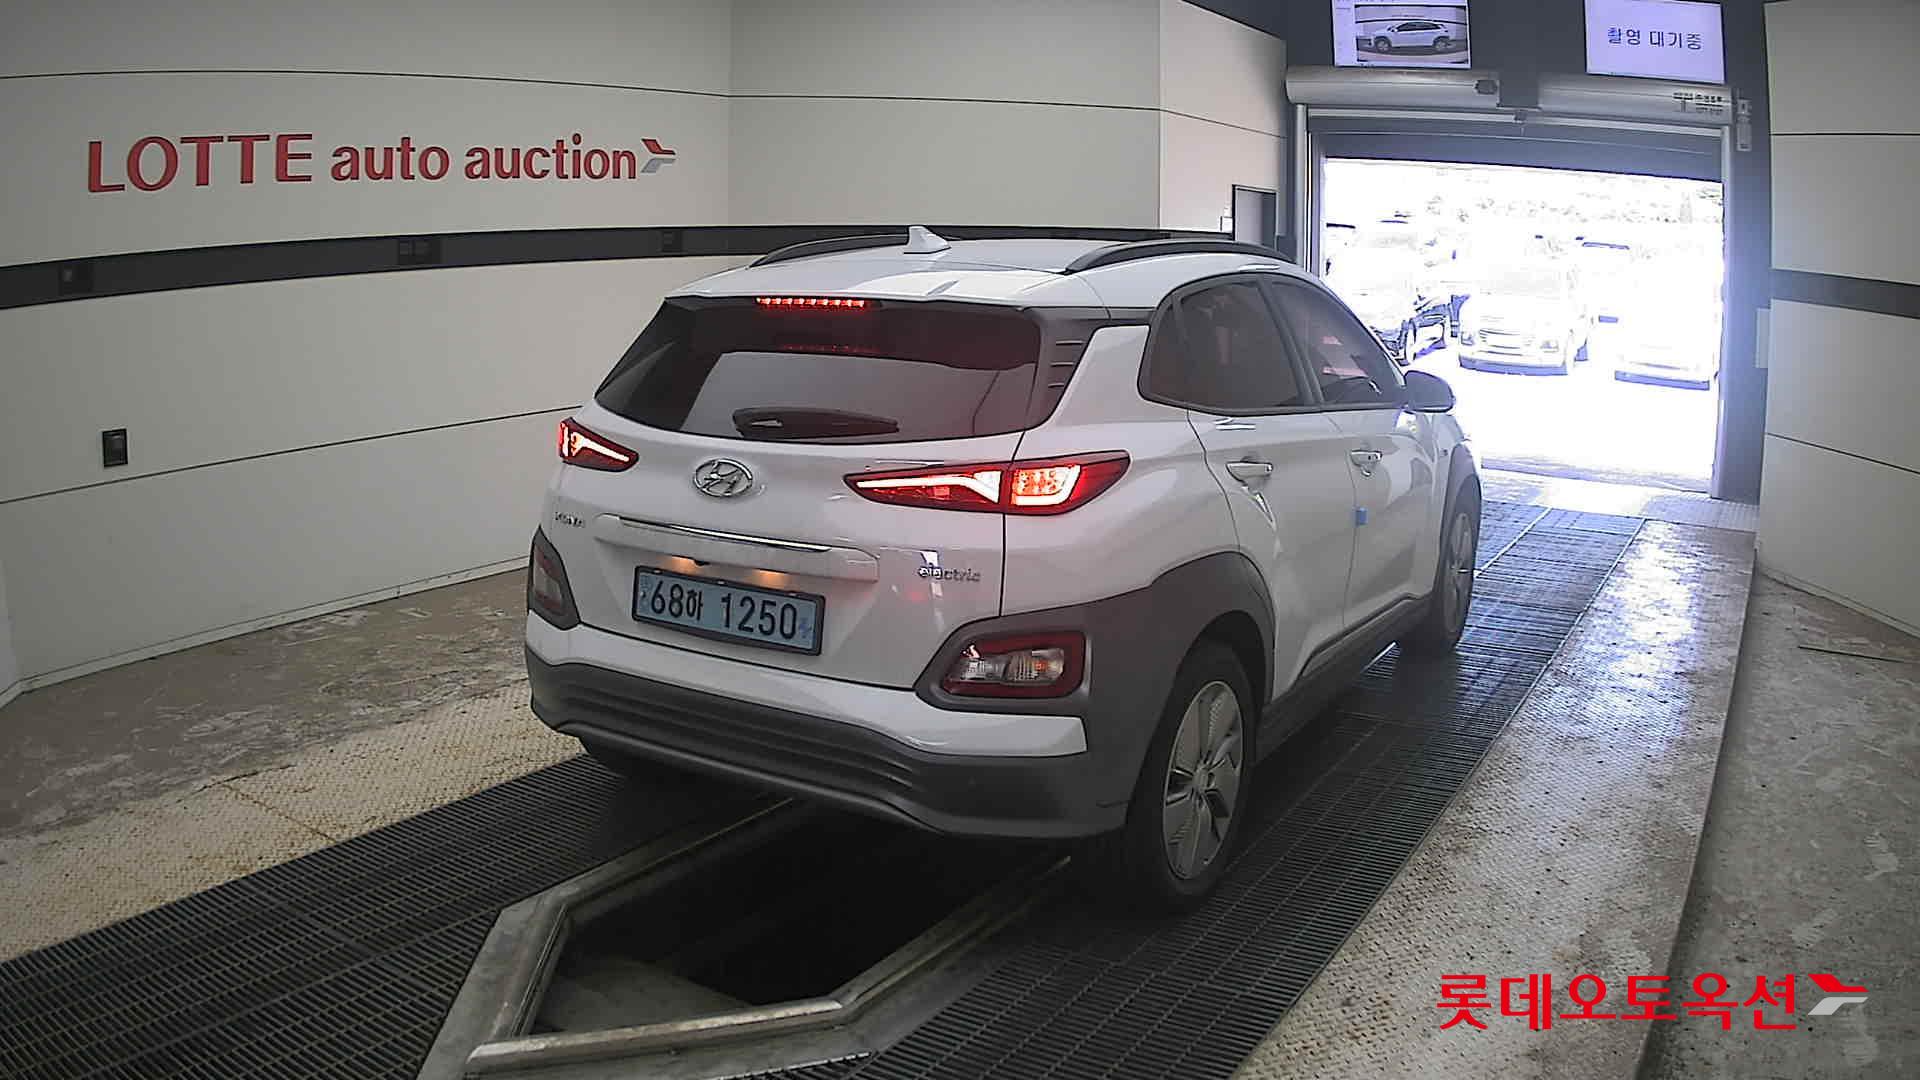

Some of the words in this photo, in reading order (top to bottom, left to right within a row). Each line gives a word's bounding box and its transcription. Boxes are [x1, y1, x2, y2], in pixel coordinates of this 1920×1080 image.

[1649, 30, 1702, 51] 대기중
[87, 133, 314, 193] LOTTE
[330, 136, 450, 182] auto
[463, 132, 637, 180] auction
[918, 563, 982, 582] electric
[651, 580, 704, 621] 68하
[721, 593, 798, 640] 1250
